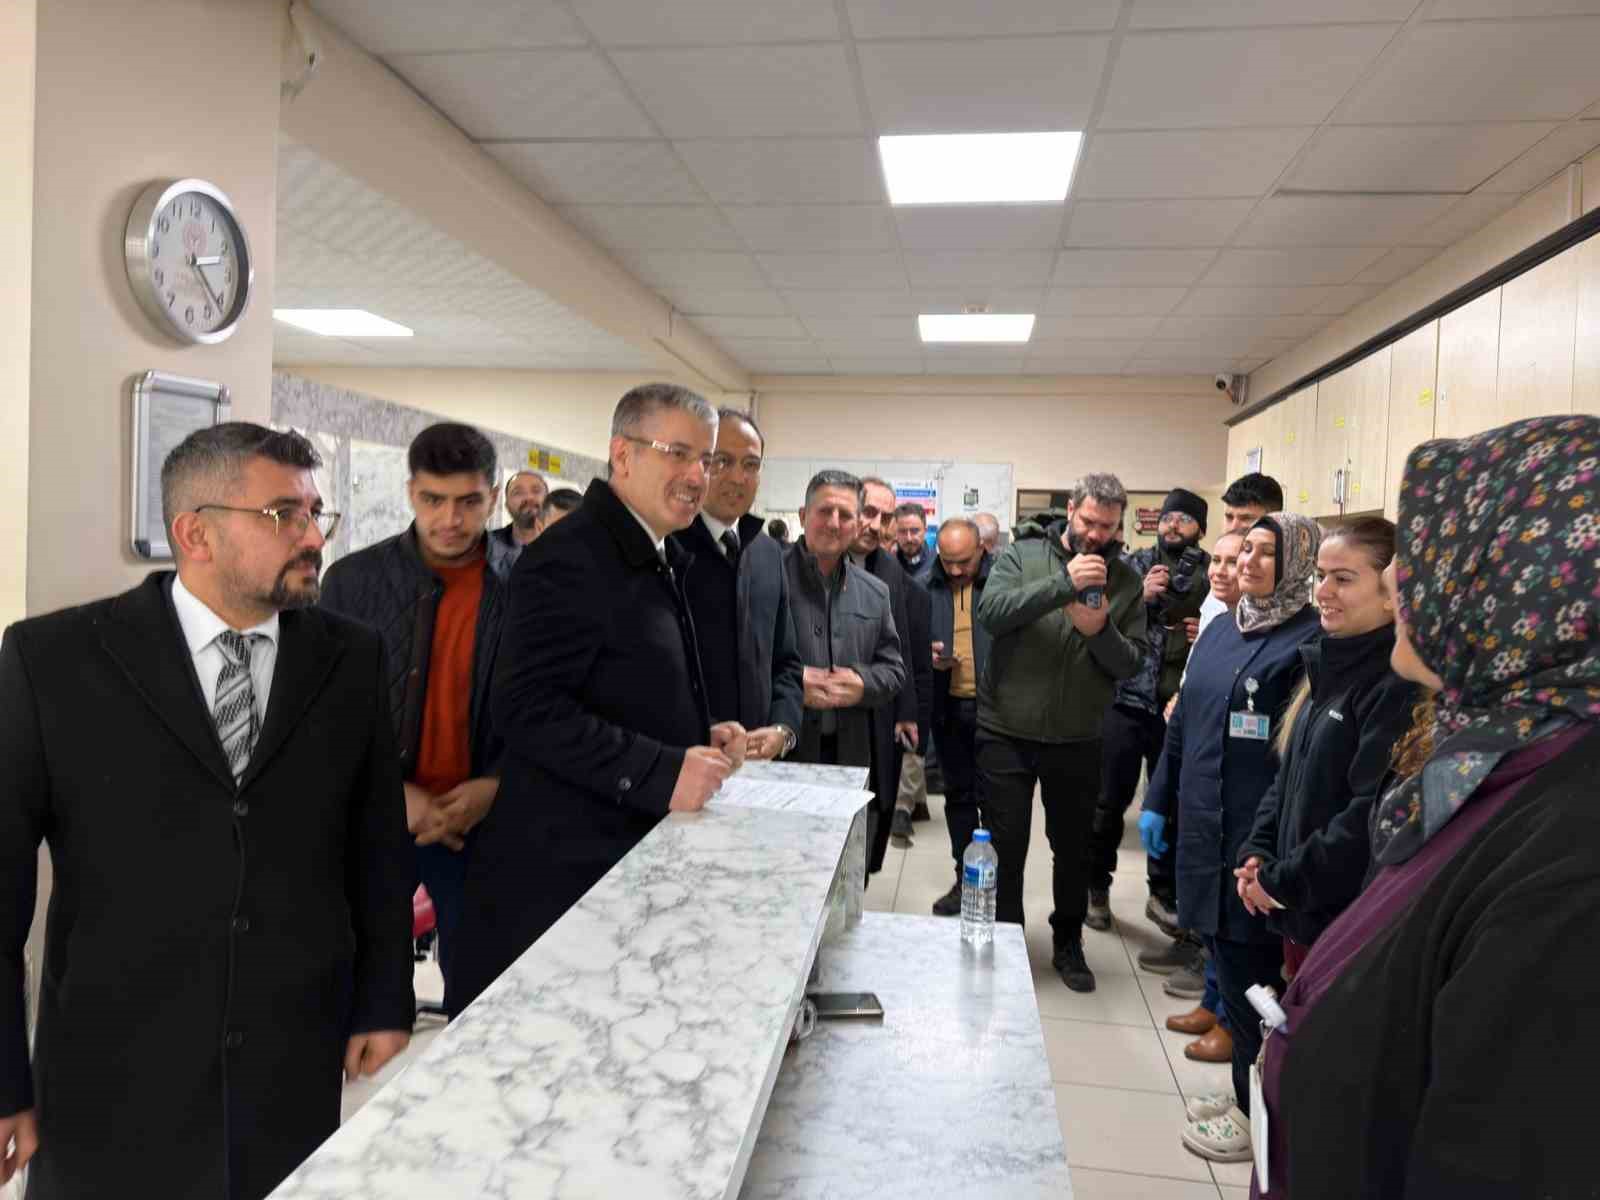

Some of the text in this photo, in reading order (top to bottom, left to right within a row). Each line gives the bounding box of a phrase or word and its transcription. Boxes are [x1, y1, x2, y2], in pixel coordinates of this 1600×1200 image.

[172, 202, 183, 220] 11
[190, 200, 202, 219] 12
[156, 216, 170, 234] 10
[211, 216, 217, 233] 1
[166, 291, 176, 309] 7
